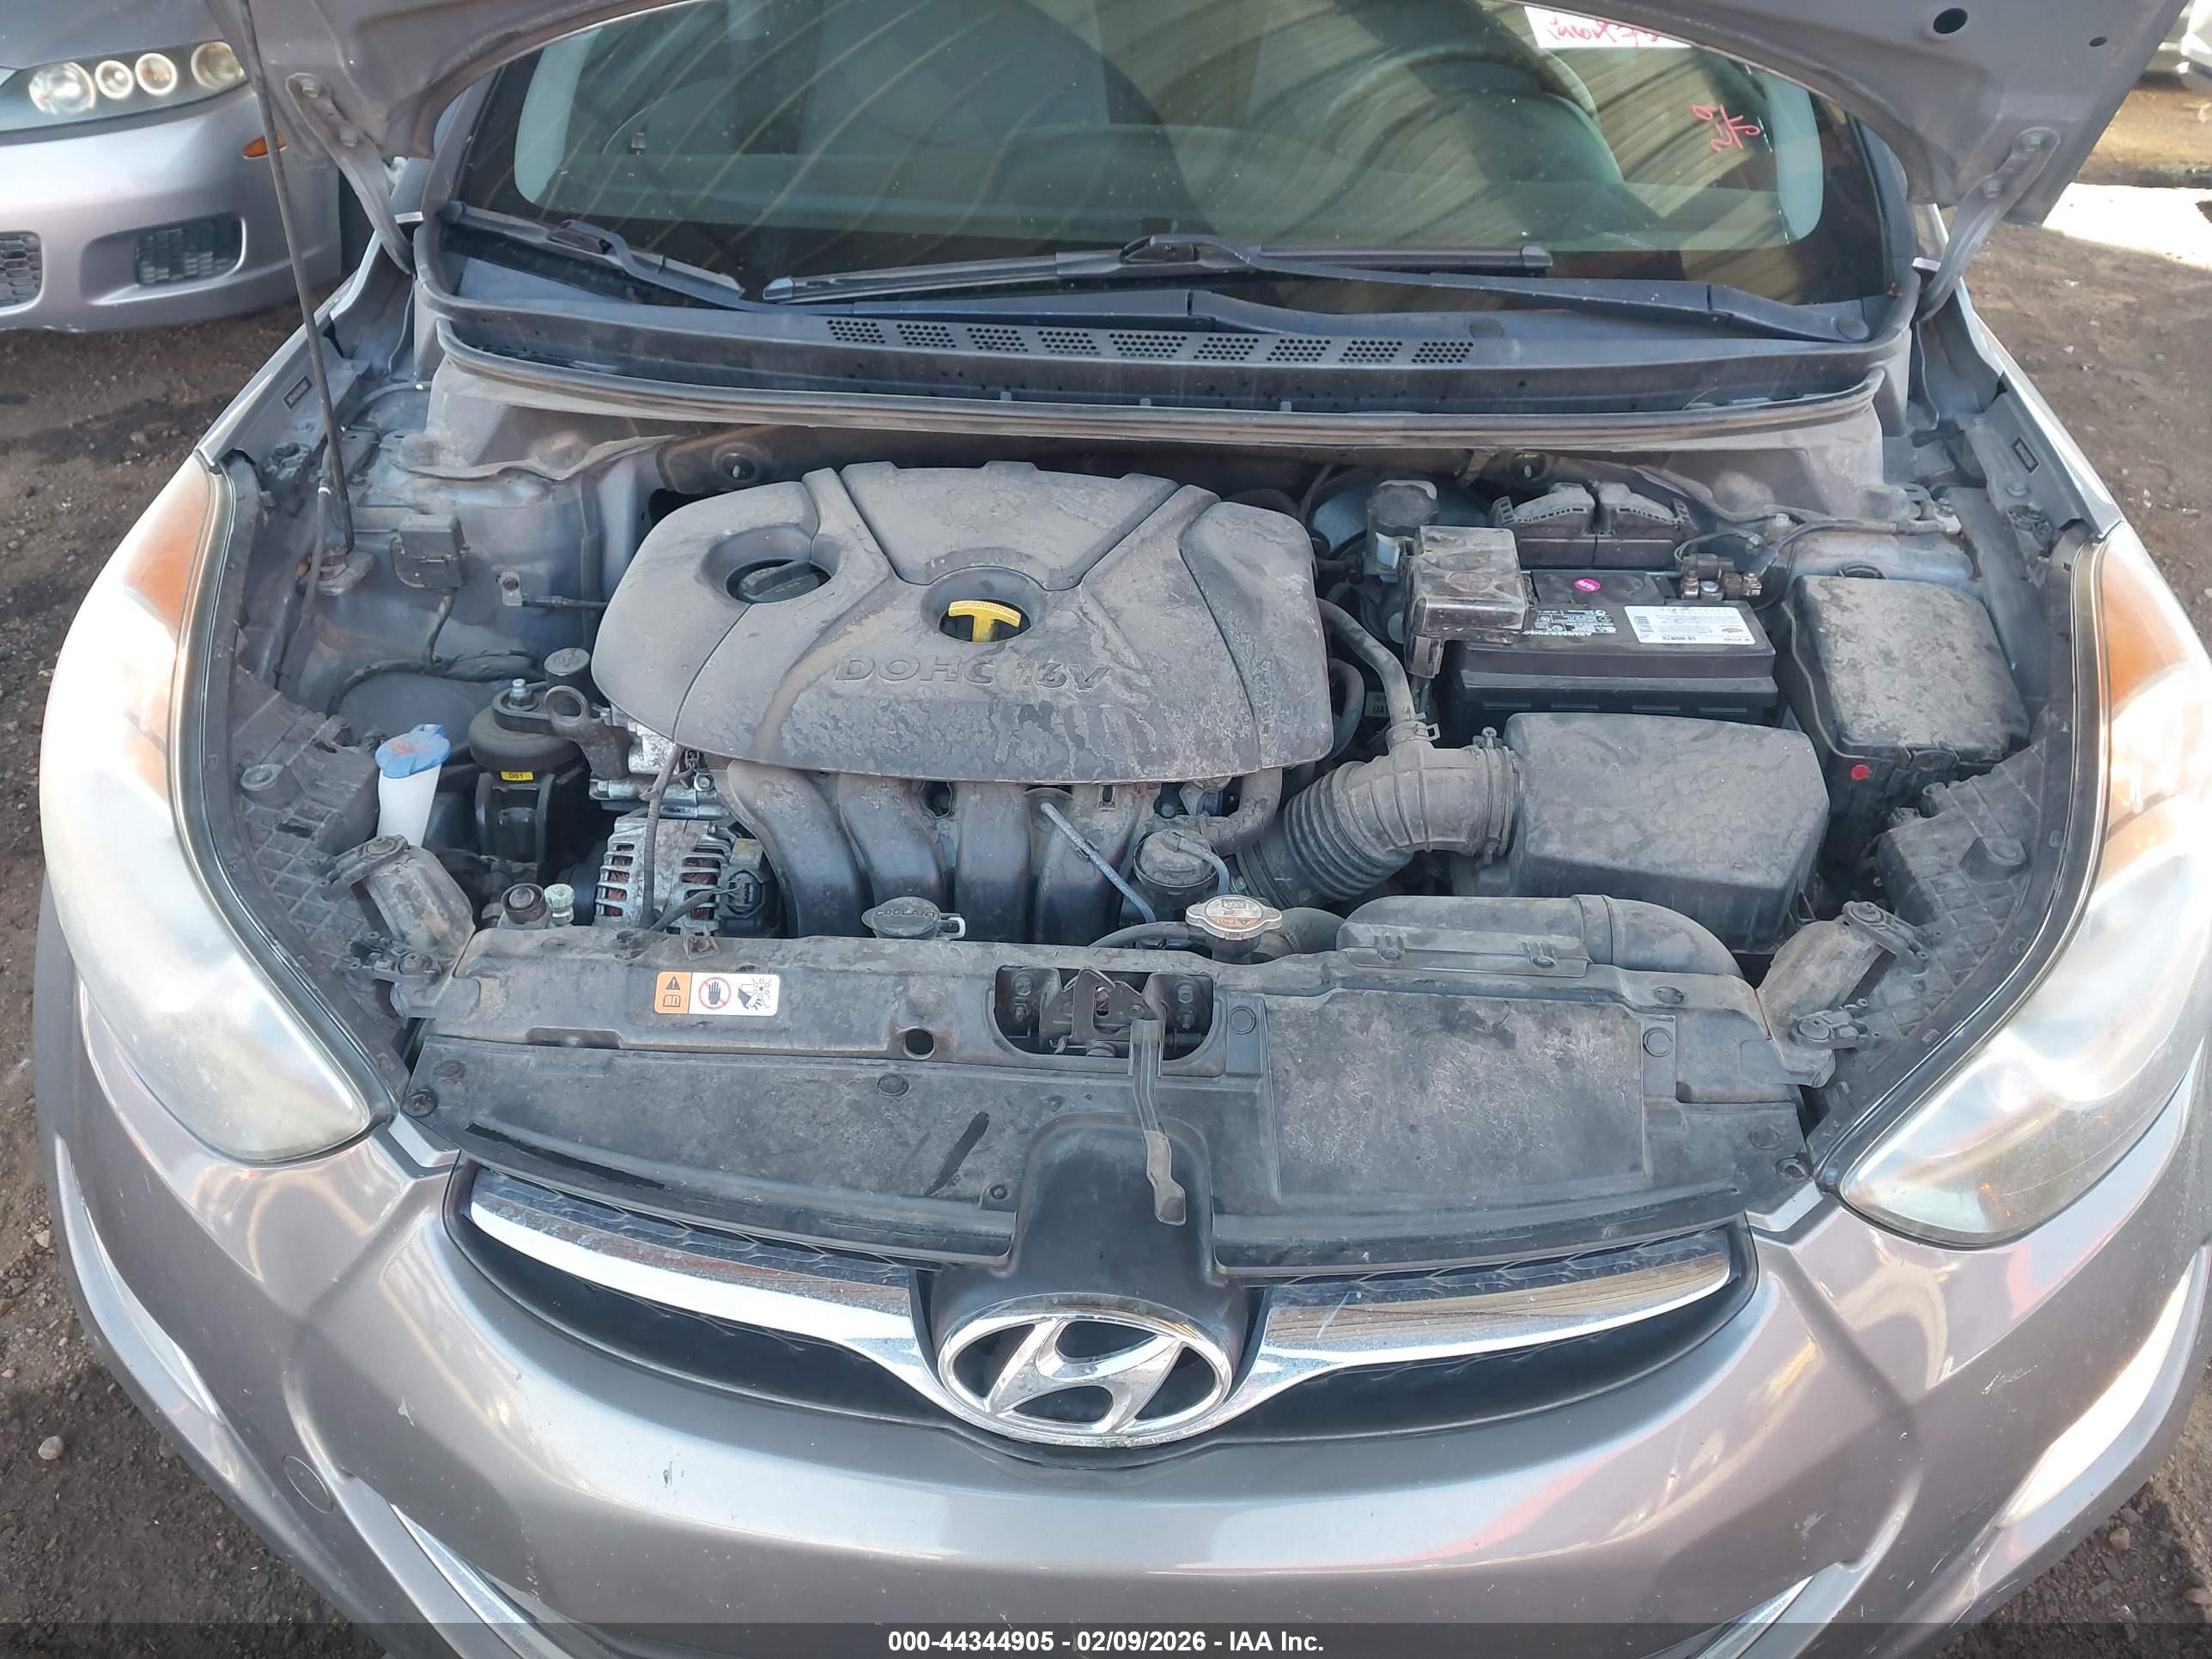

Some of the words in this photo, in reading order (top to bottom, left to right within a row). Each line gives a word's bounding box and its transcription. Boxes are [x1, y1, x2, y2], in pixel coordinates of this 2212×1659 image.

[836, 654, 996, 684] DOHC
[1016, 659, 1110, 691] 16V
[875, 908, 939, 919] COOLANT
